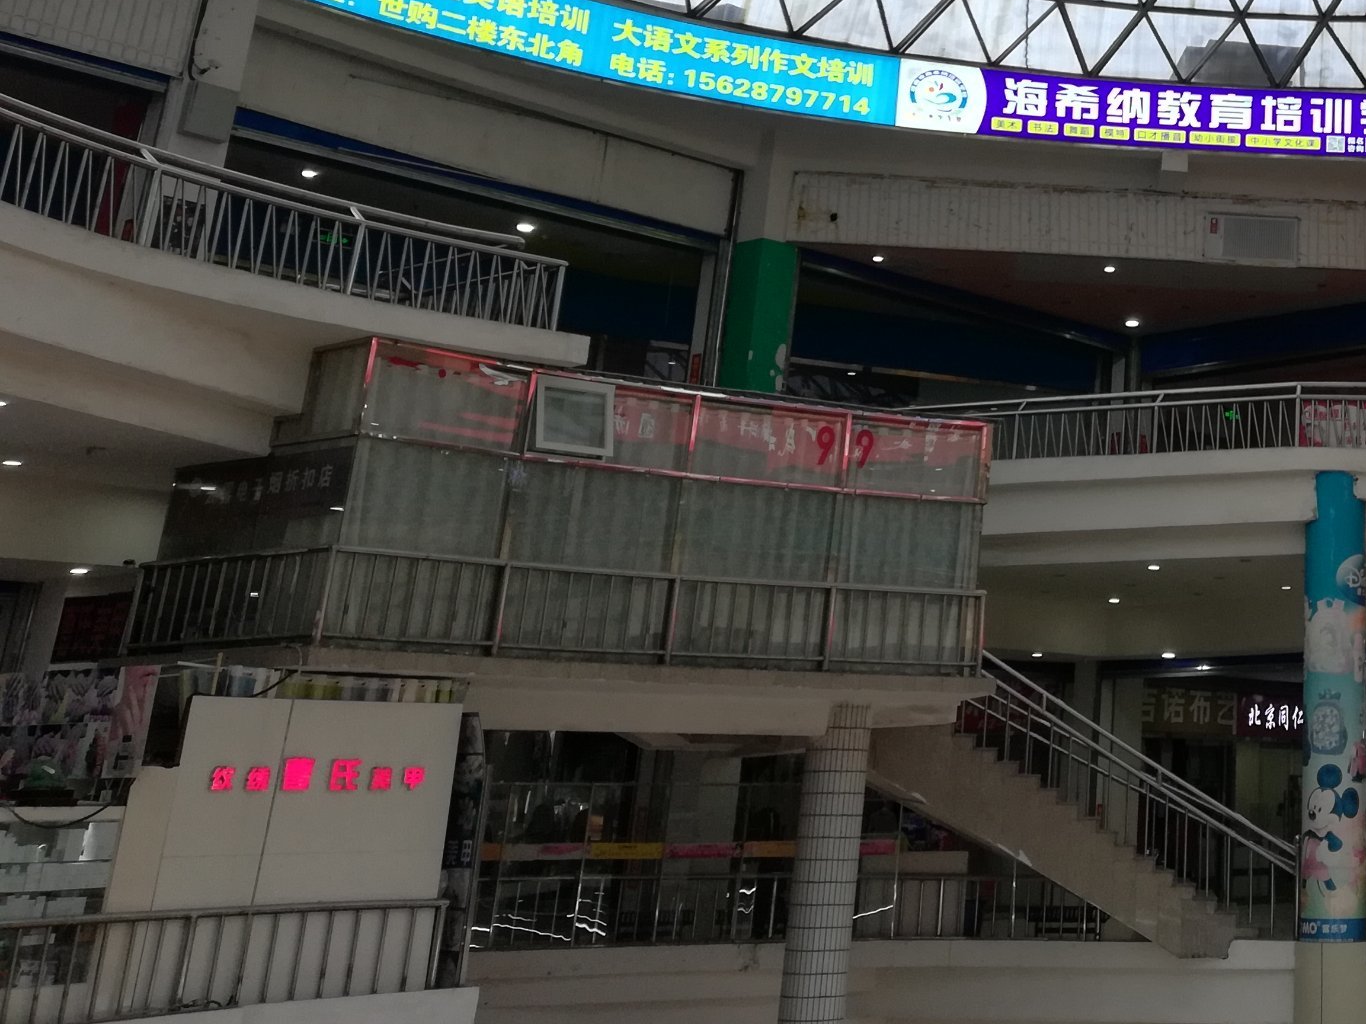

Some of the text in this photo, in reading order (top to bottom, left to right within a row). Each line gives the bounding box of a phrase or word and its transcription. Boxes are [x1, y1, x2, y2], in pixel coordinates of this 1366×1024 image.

[612, 19, 875, 88] 大语文系列作文培训
[1248, 703, 1304, 731] 北京同仁
